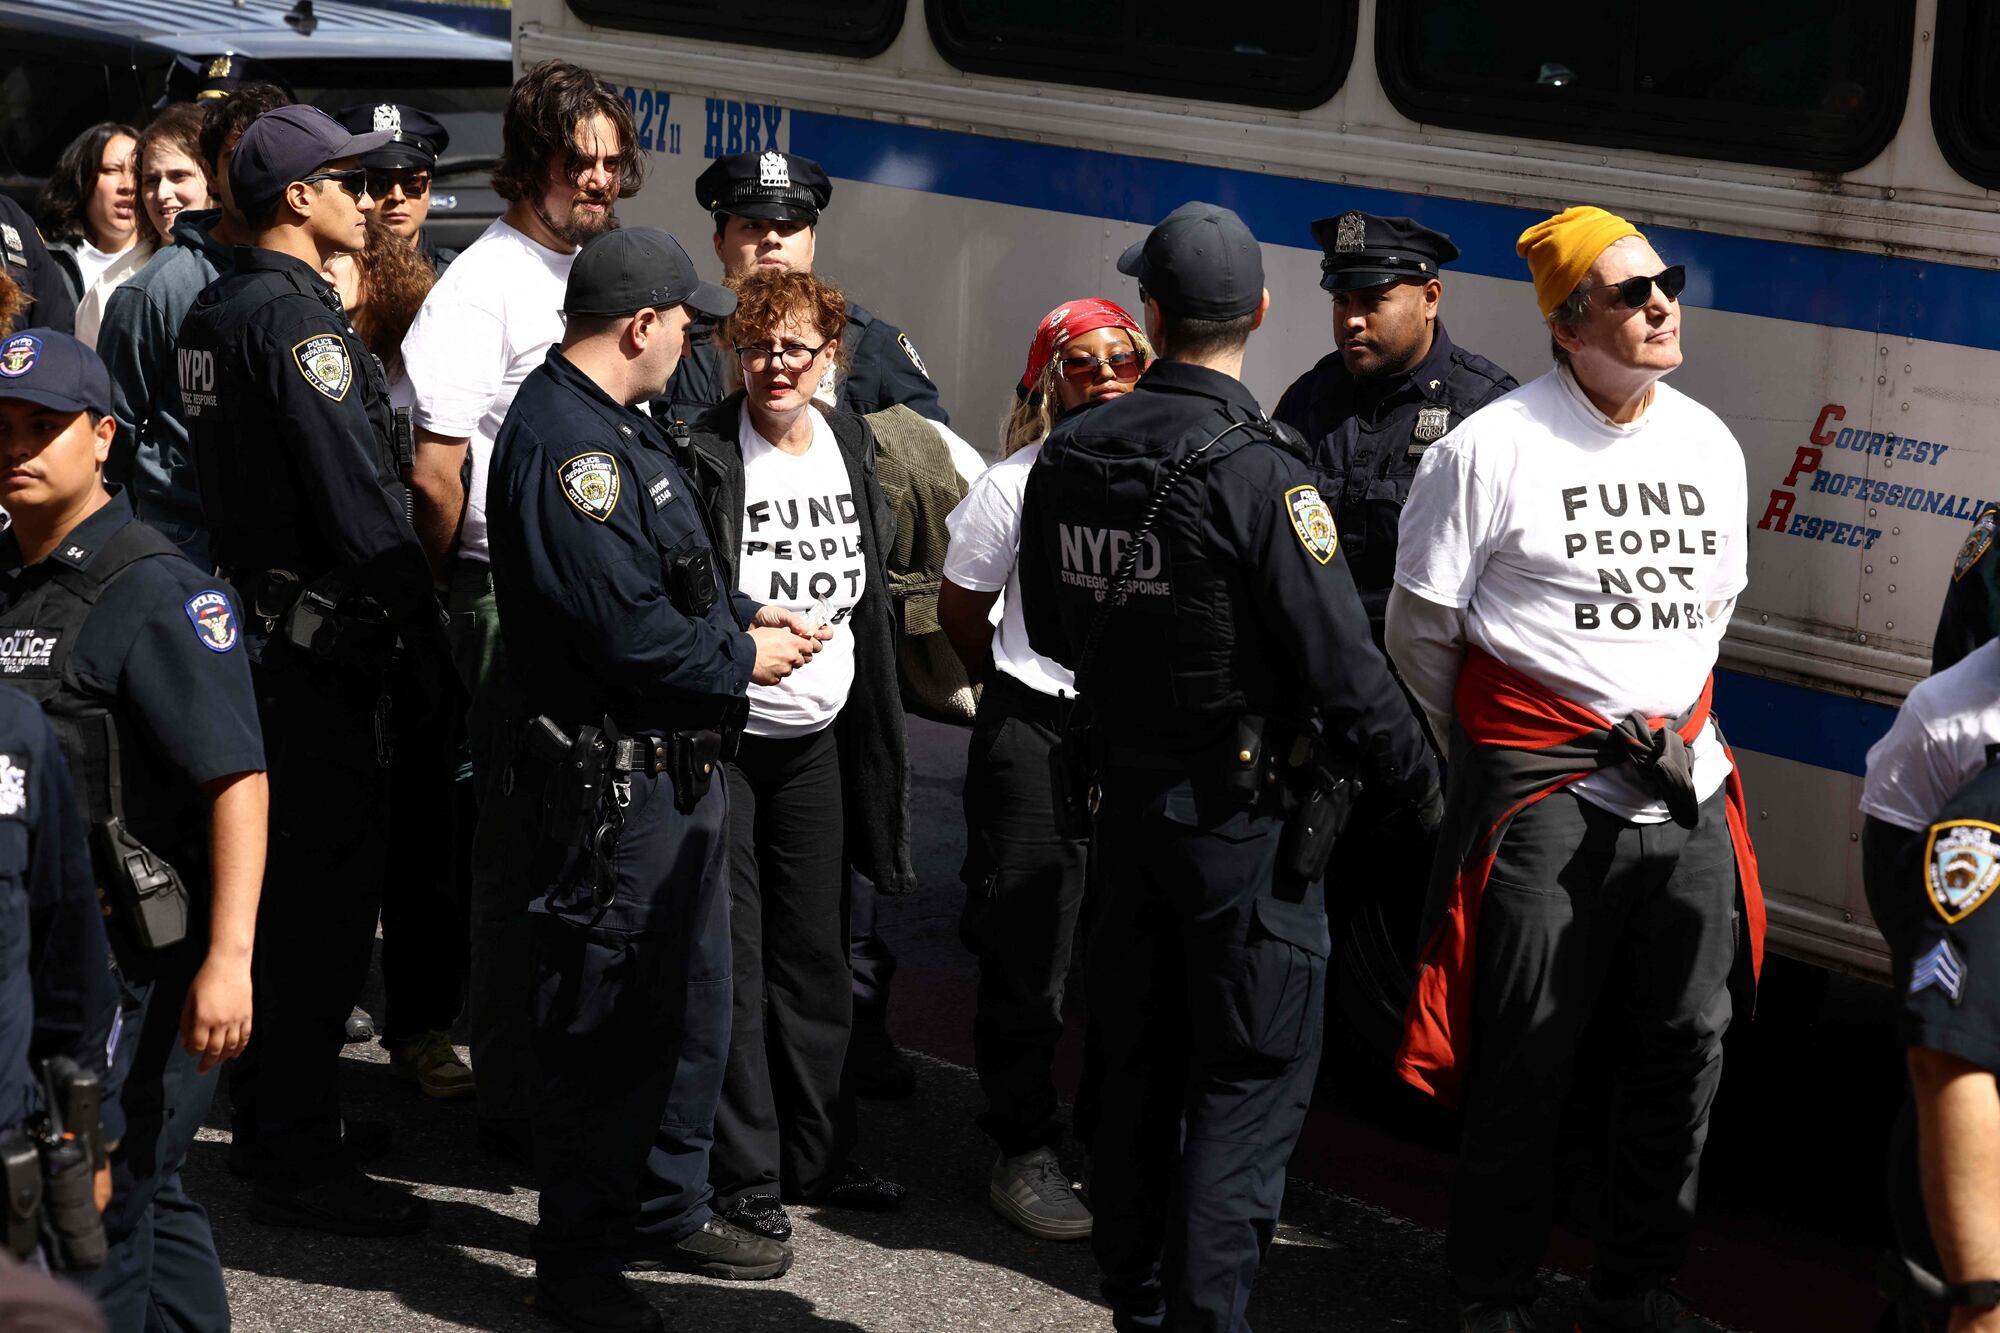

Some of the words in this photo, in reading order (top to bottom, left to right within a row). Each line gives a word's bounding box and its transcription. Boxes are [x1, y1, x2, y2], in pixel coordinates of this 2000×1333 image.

[300, 344, 343, 362] DEPARTMENT
[306, 338, 333, 350] POLICE
[305, 369, 319, 384] CITY
[1809, 403, 1949, 466] COURTESY
[564, 463, 612, 482] DEPARTMENT
[571, 456, 600, 470] POLICE
[568, 489, 583, 504] CITY
[1562, 482, 1705, 521] FUND
[746, 494, 858, 532] FUND
[1757, 489, 1882, 549] RESPECT
[1059, 523, 1161, 580] NYPD
[1565, 529, 1717, 559] PEOPLE
[769, 569, 861, 600] NOT
[1061, 570, 1109, 590] STRATEGIC
[1117, 580, 1171, 596] SPONSE
[1597, 566, 1695, 594] NOT
[191, 594, 226, 613] POLICE
